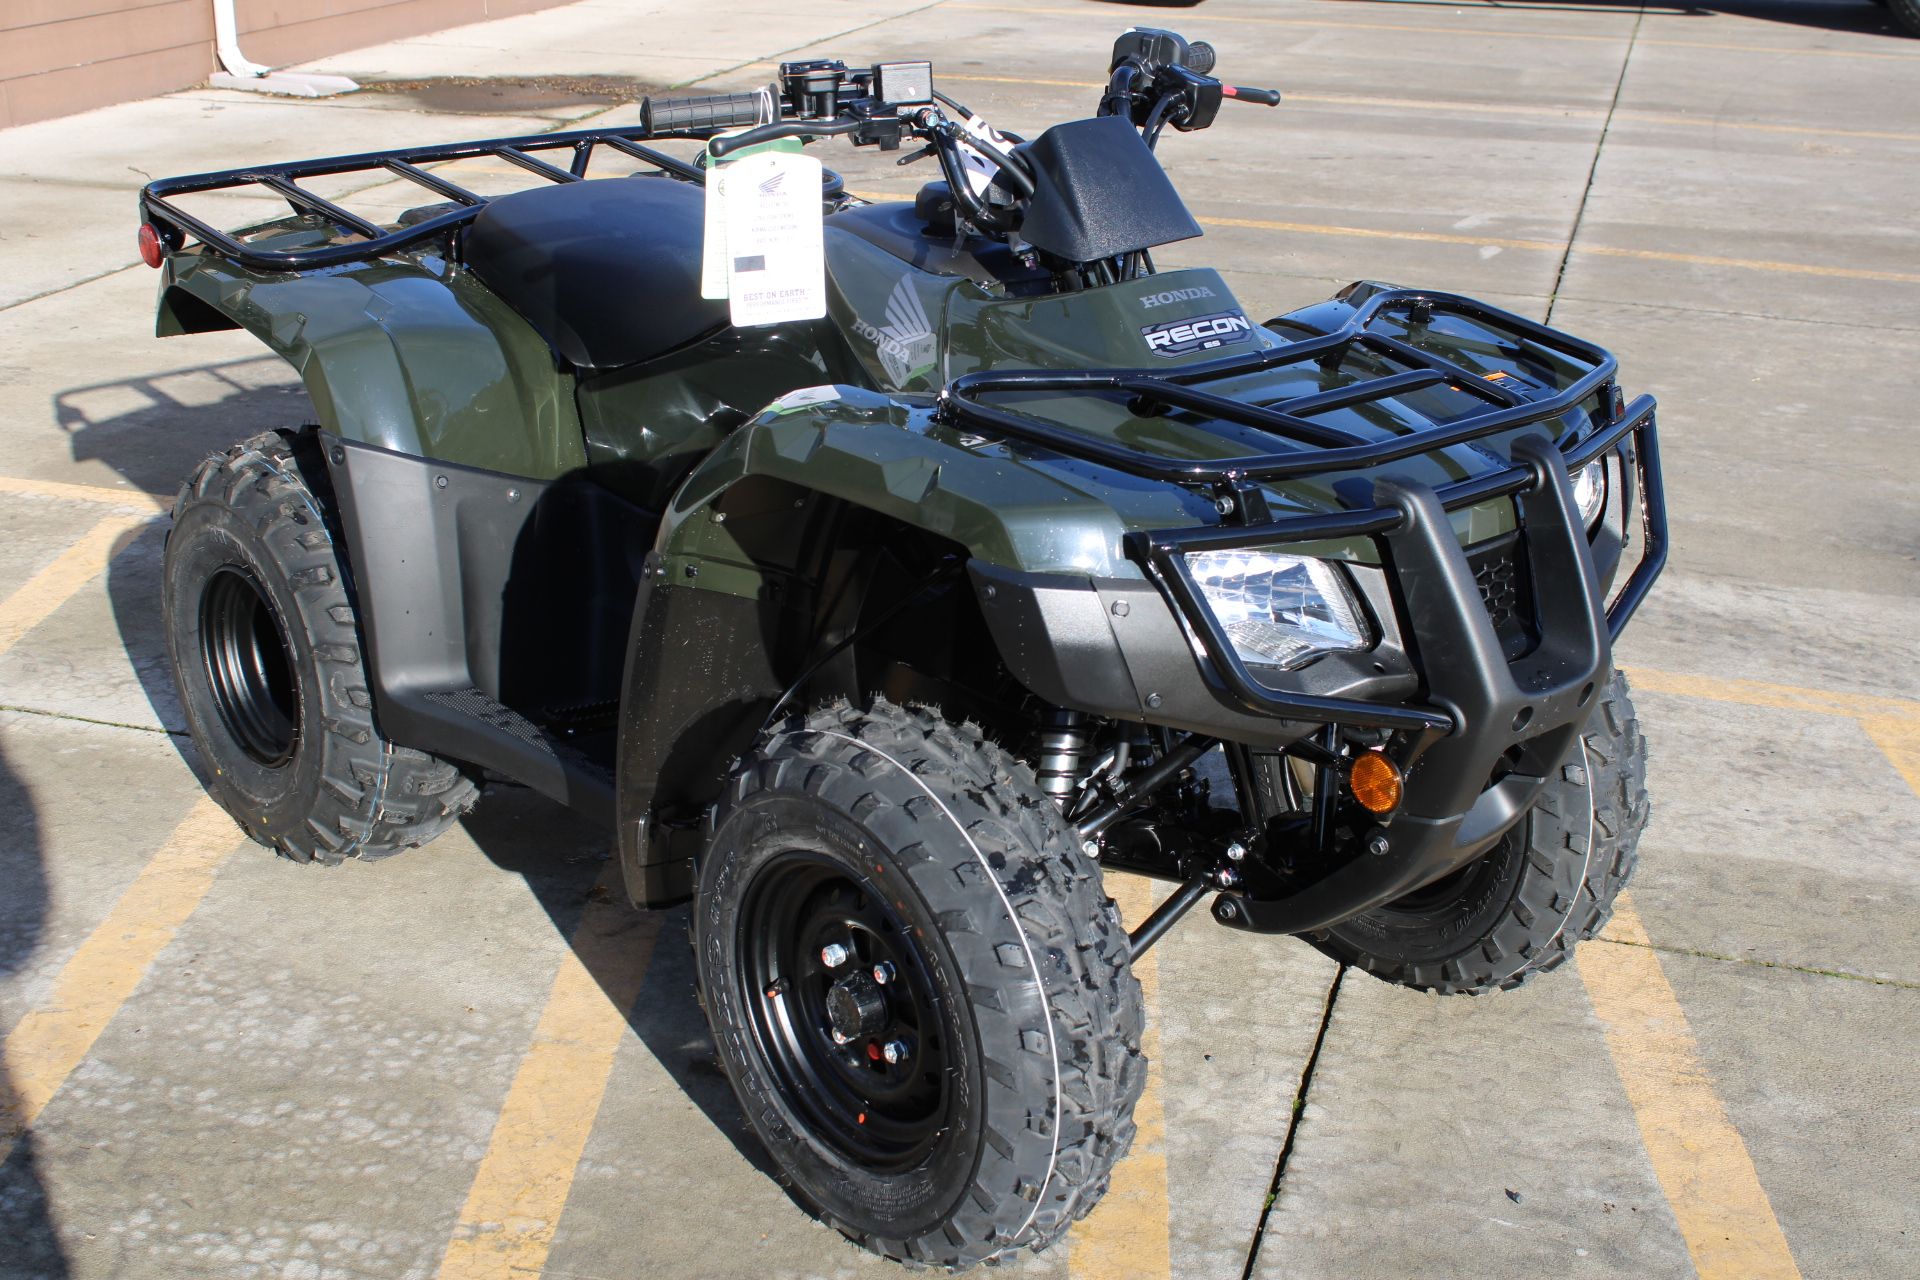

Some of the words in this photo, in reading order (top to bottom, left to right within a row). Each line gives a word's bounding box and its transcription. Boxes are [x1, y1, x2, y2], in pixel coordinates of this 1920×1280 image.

[744, 292, 763, 302] BEST
[766, 291, 777, 299] ON
[779, 289, 806, 298] EARTH
[1139, 286, 1216, 309] HONDA
[851, 318, 910, 364] HONDA
[1144, 316, 1251, 350] RECON
